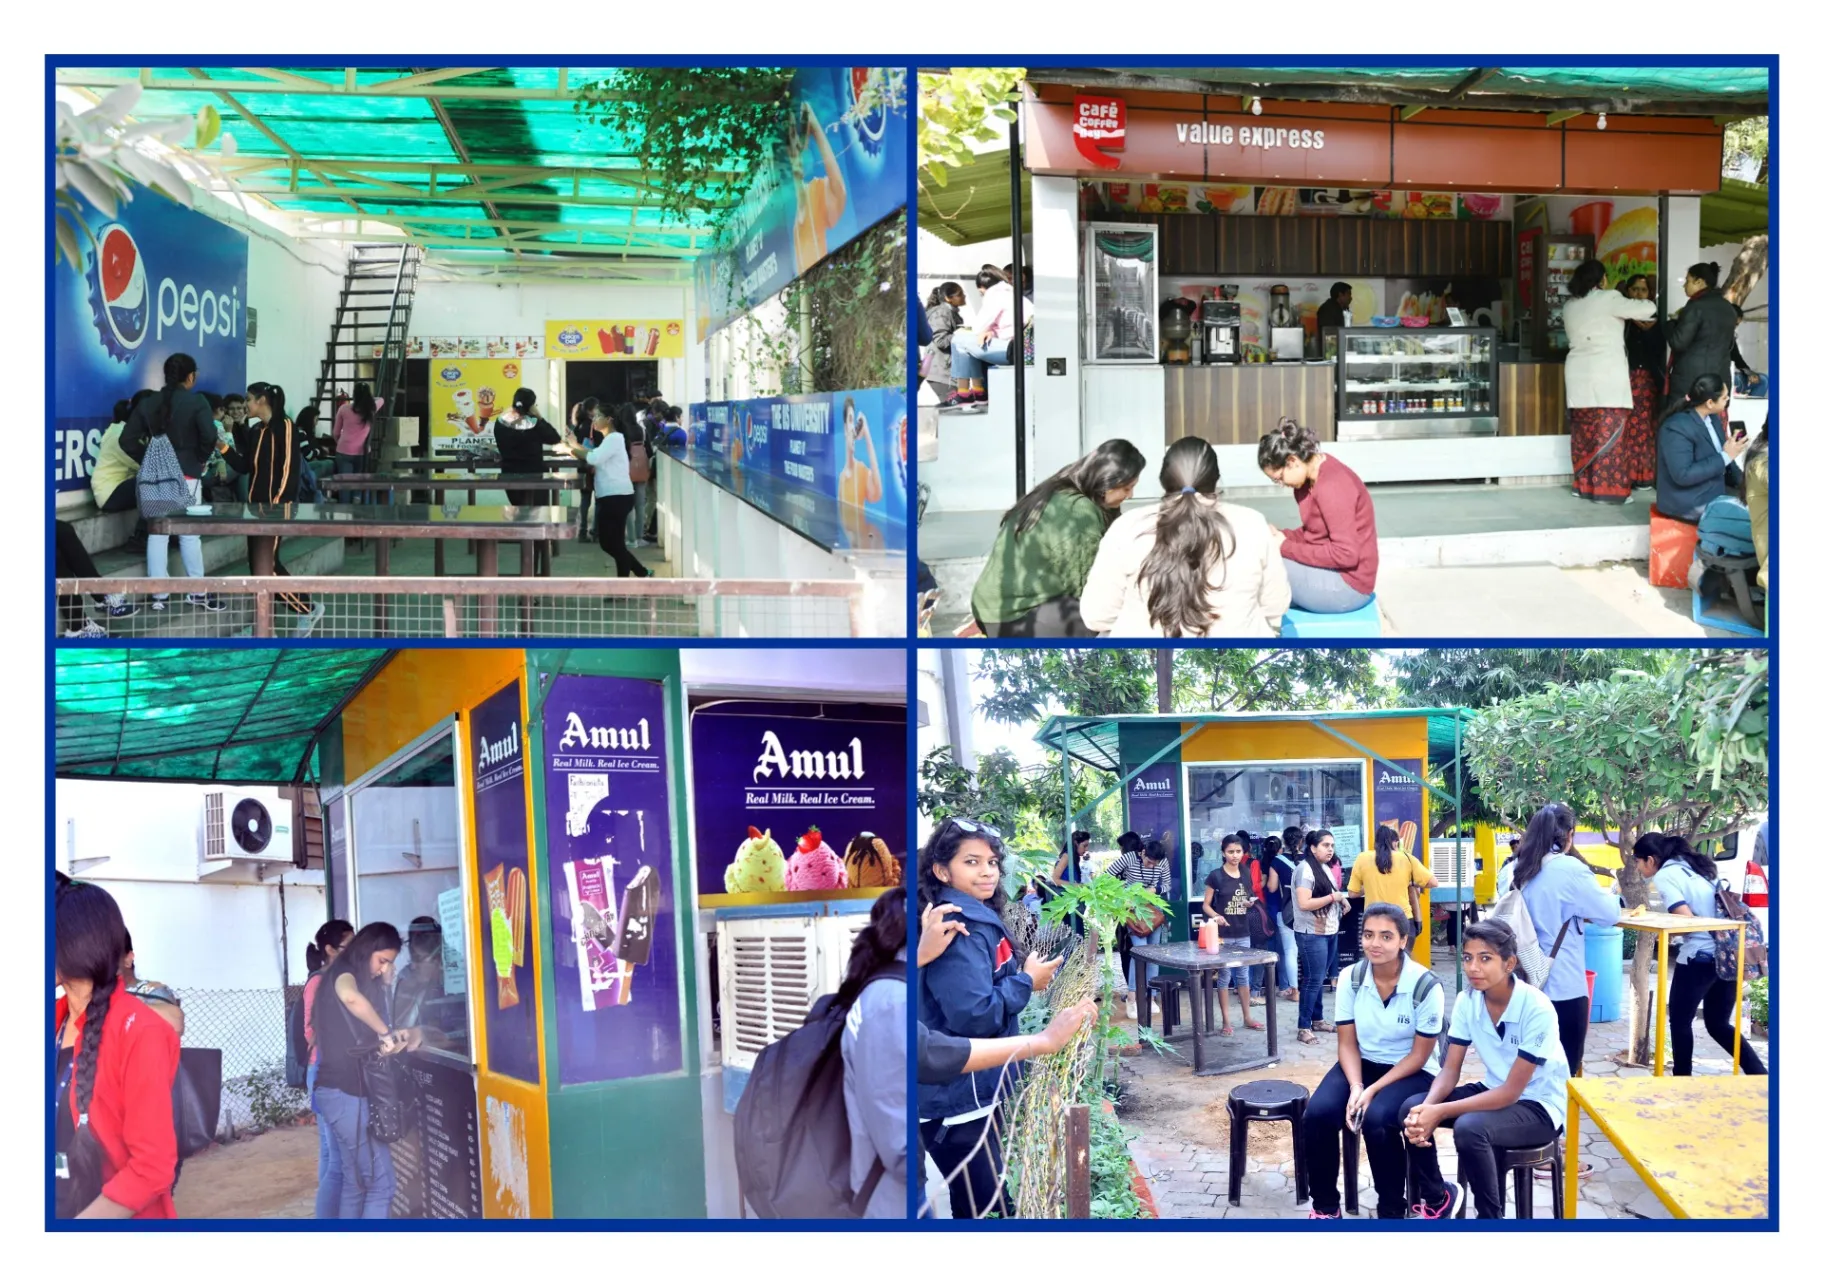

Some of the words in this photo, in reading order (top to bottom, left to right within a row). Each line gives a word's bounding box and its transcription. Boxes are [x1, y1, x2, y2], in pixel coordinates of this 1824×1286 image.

[1176, 121, 1234, 145] value
[1239, 126, 1325, 149] express
[157, 277, 237, 348] pepsi
[478, 721, 519, 775] Amul
[559, 711, 652, 752] Amul
[553, 757, 573, 768] Real
[574, 758, 596, 768] Milk.
[597, 759, 616, 769] Real
[617, 759, 630, 769] Ice
[631, 759, 660, 769] Cream.
[753, 730, 866, 784] Amul
[745, 792, 769, 804] Real
[771, 792, 798, 804] Milk.
[799, 792, 822, 804] Real
[824, 793, 839, 804] Ice
[840, 792, 876, 804] Cream.
[1133, 777, 1171, 792] Amul
